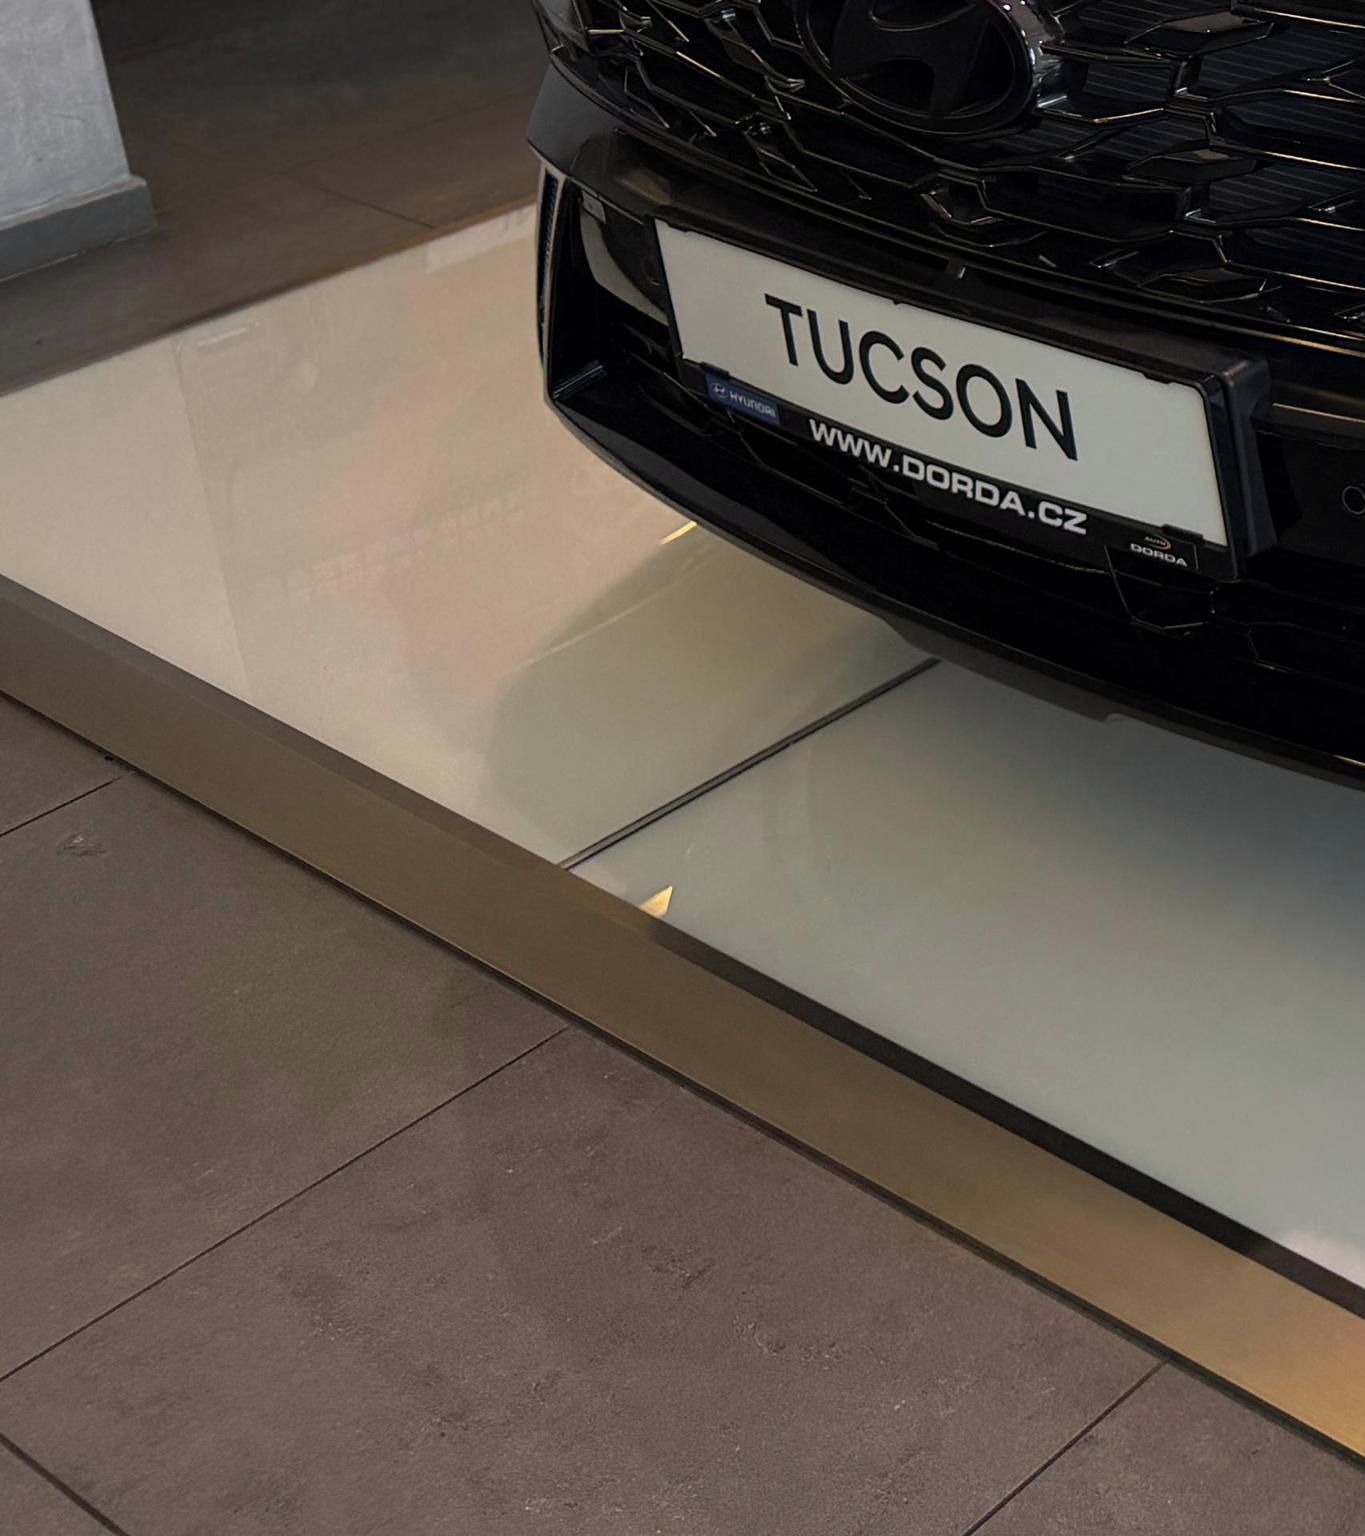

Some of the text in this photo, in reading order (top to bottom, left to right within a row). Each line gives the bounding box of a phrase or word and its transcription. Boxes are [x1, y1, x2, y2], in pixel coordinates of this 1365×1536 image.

[729, 390, 776, 418] HYUNDAI
[764, 293, 1078, 462] TUCSON
[809, 419, 1088, 535] WWW.DORDA.CZ
[1130, 543, 1188, 568] DORDA
